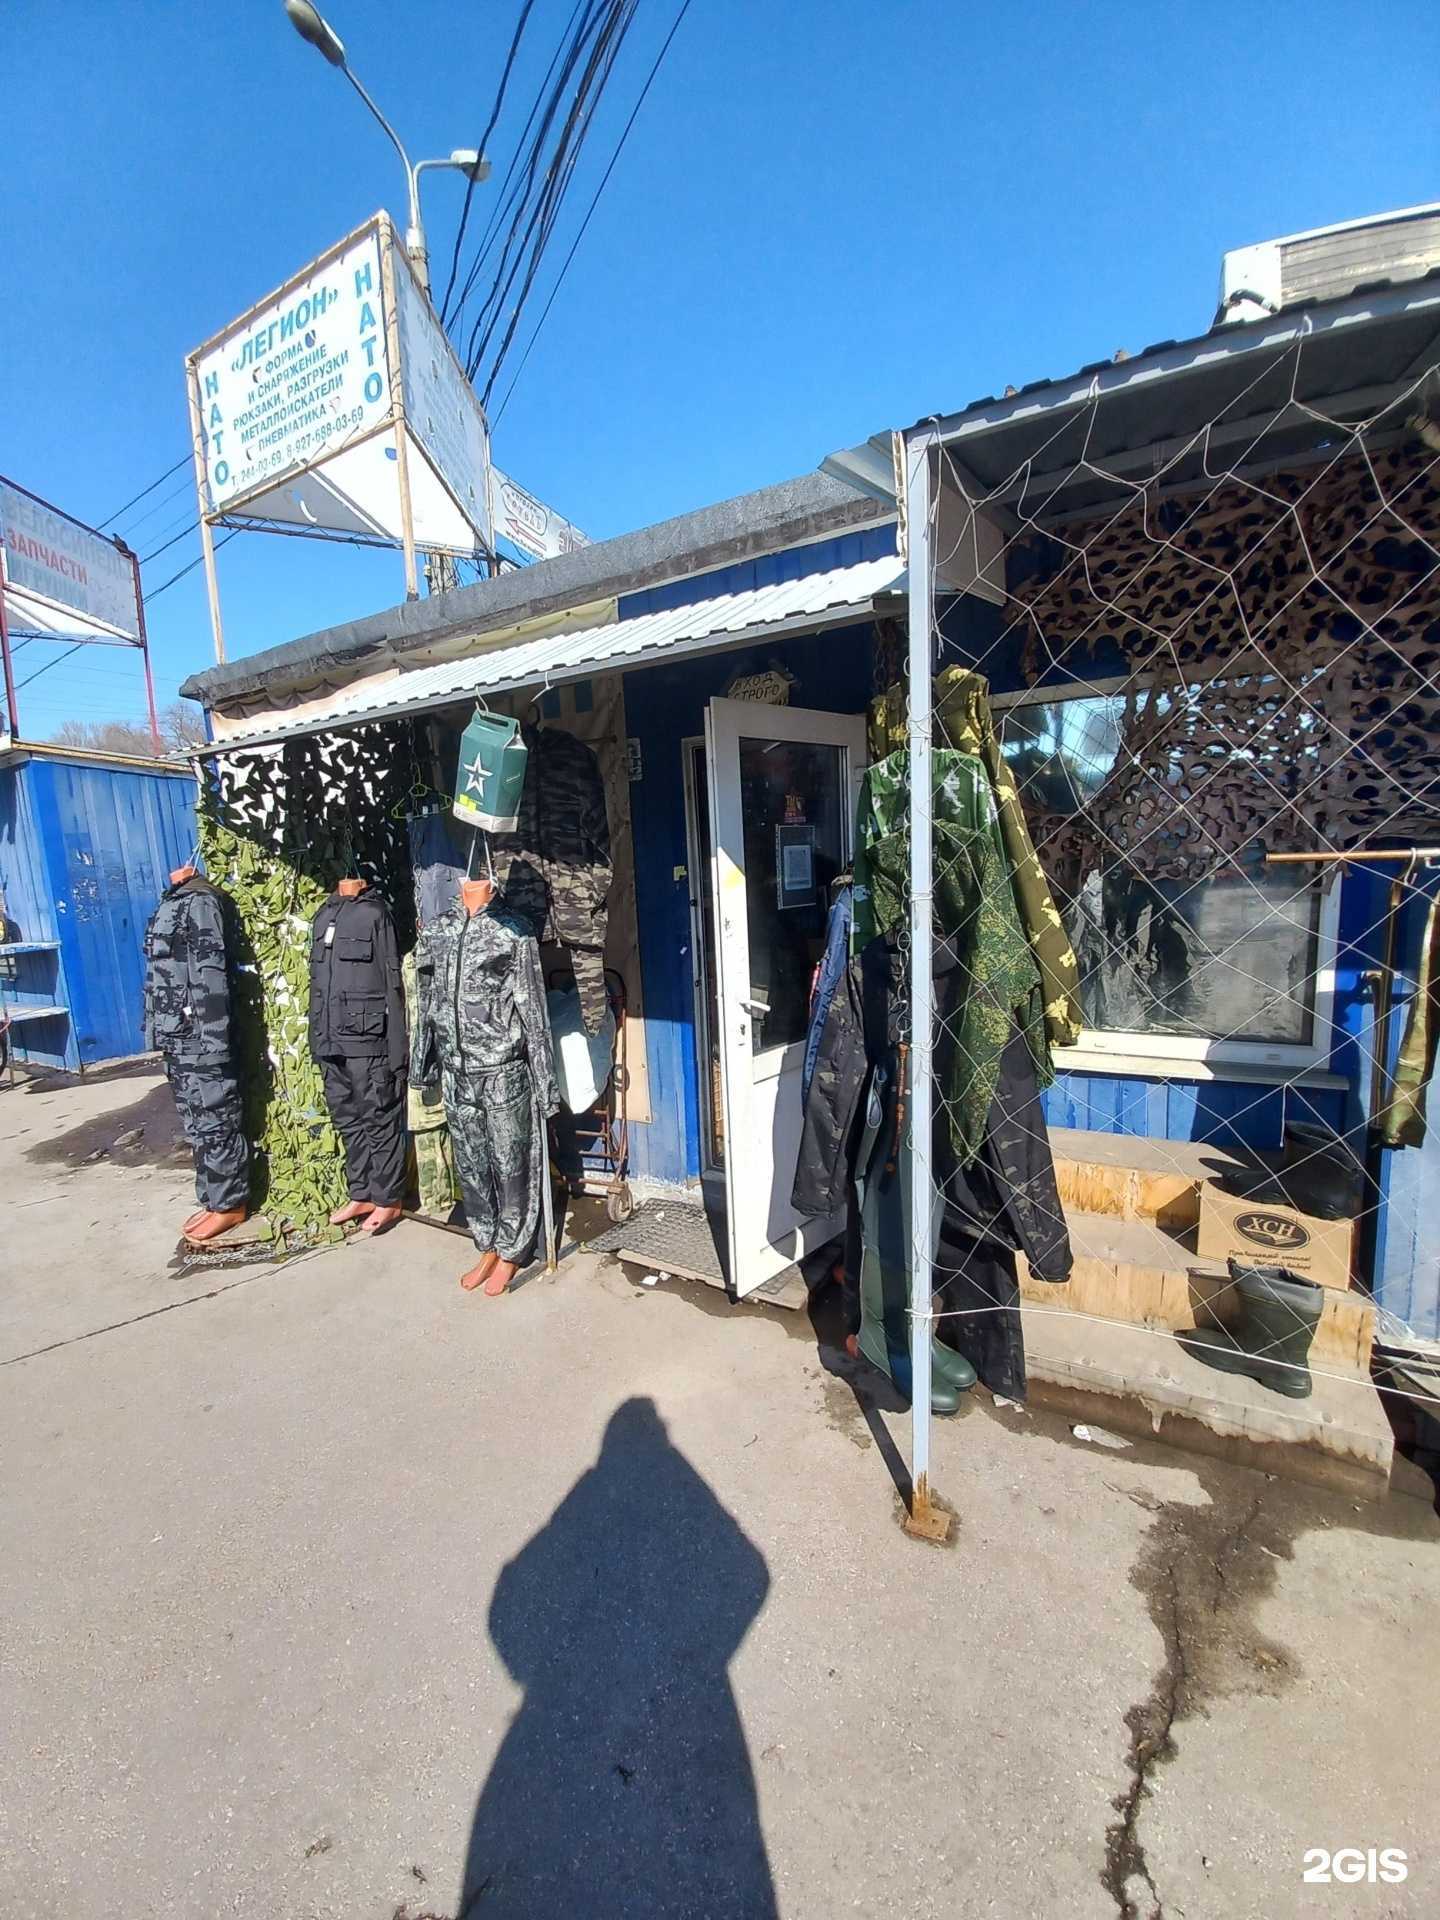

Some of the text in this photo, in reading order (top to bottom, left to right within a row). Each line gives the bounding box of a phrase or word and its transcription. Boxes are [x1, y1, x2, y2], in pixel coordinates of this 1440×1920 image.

[231, 286, 338, 373] «ЛЕГИОН»
[265, 341, 303, 374] ФОРМА
[354, 262, 383, 403] НАТО
[233, 349, 349, 431] РЮКЗАКИ, РАЗГРУЗКИ
[248, 344, 327, 404] И СНАРЯЖЕНИЕ
[205, 371, 229, 486] НАТО
[241, 374, 344, 445] МЕТАЛЛОИСКАТЕЛИ
[259, 403, 326, 452] ПНЕВМАТИКА
[286, 405, 364, 459] 8-927-688-03-69
[8, 527, 88, 585] ЗАПЧАСТИ
